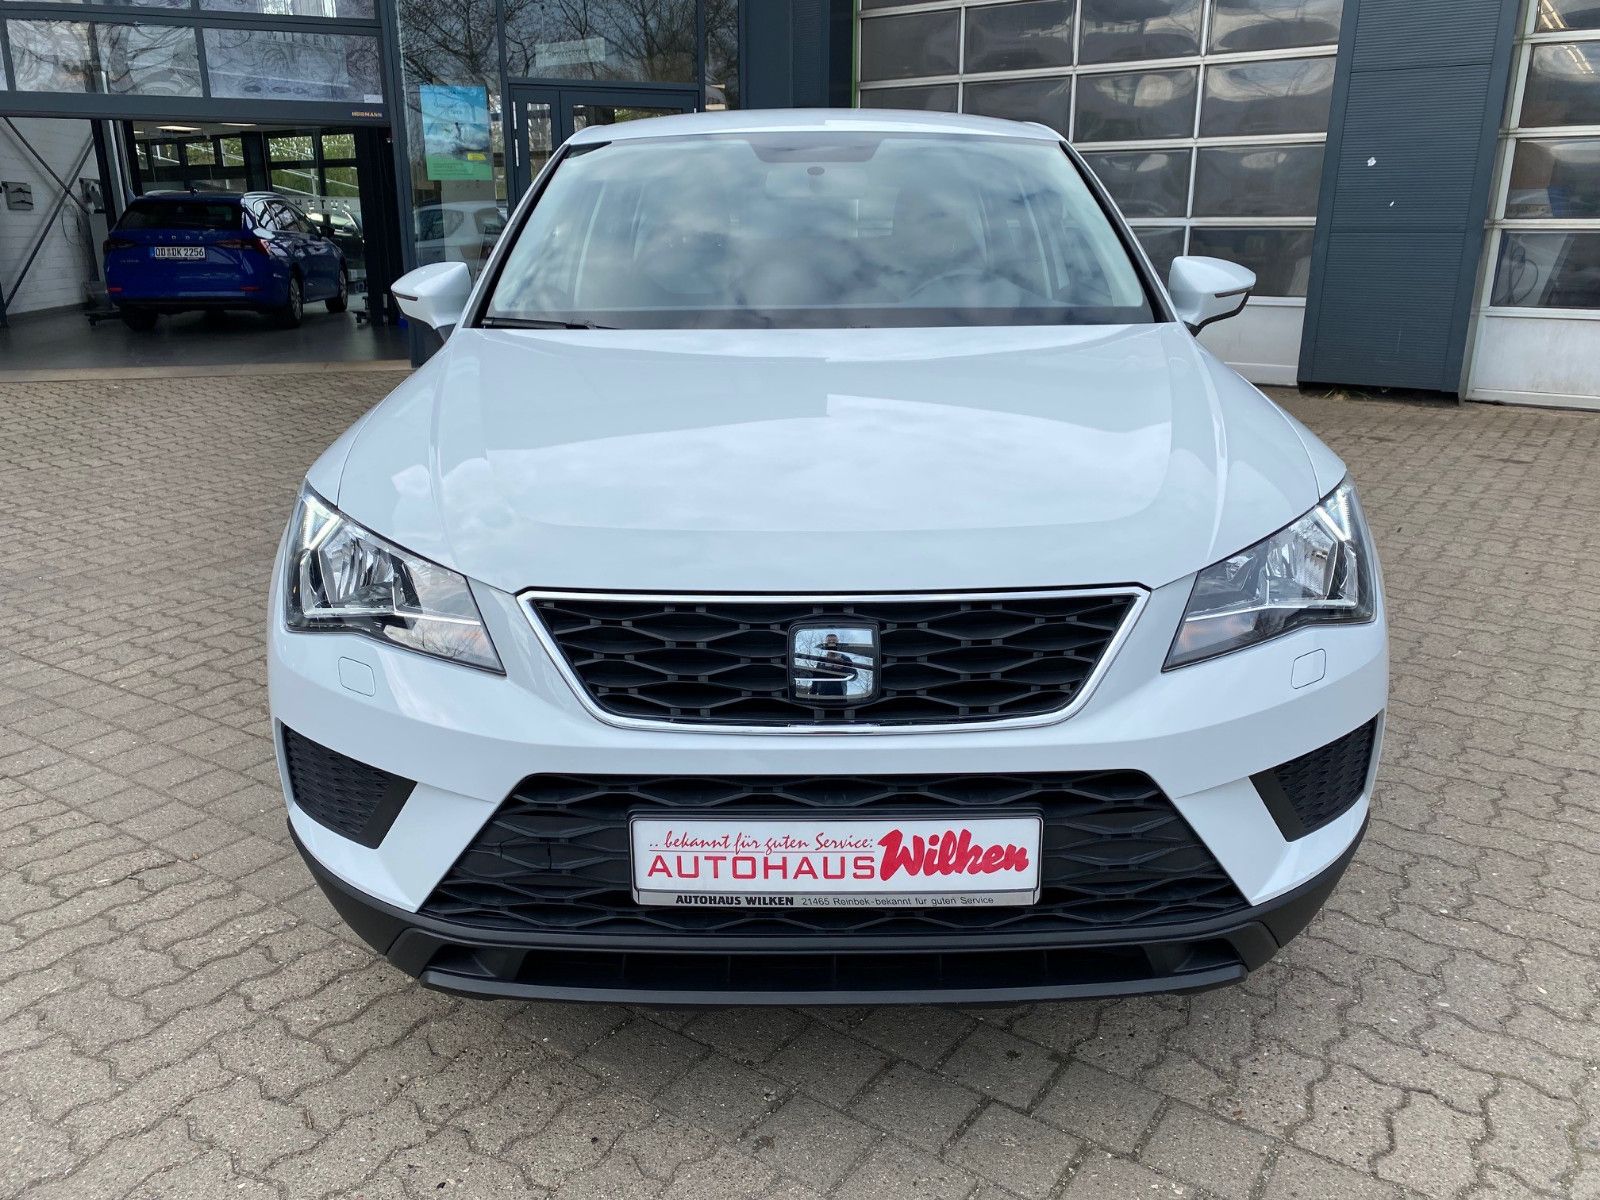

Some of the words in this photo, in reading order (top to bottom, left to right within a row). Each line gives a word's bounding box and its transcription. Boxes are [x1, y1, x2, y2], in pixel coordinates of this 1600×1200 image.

[184, 247, 204, 257] 2256
[734, 832, 760, 855] für
[764, 834, 809, 855] guten
[647, 854, 875, 880] AUTOHAUS
[877, 829, 1029, 881] Wilken
[675, 894, 742, 905] AUTOHAUS
[744, 896, 794, 906] WILKEN
[802, 897, 830, 906] 21465
[931, 897, 957, 907] guten
[960, 896, 994, 905] Service
